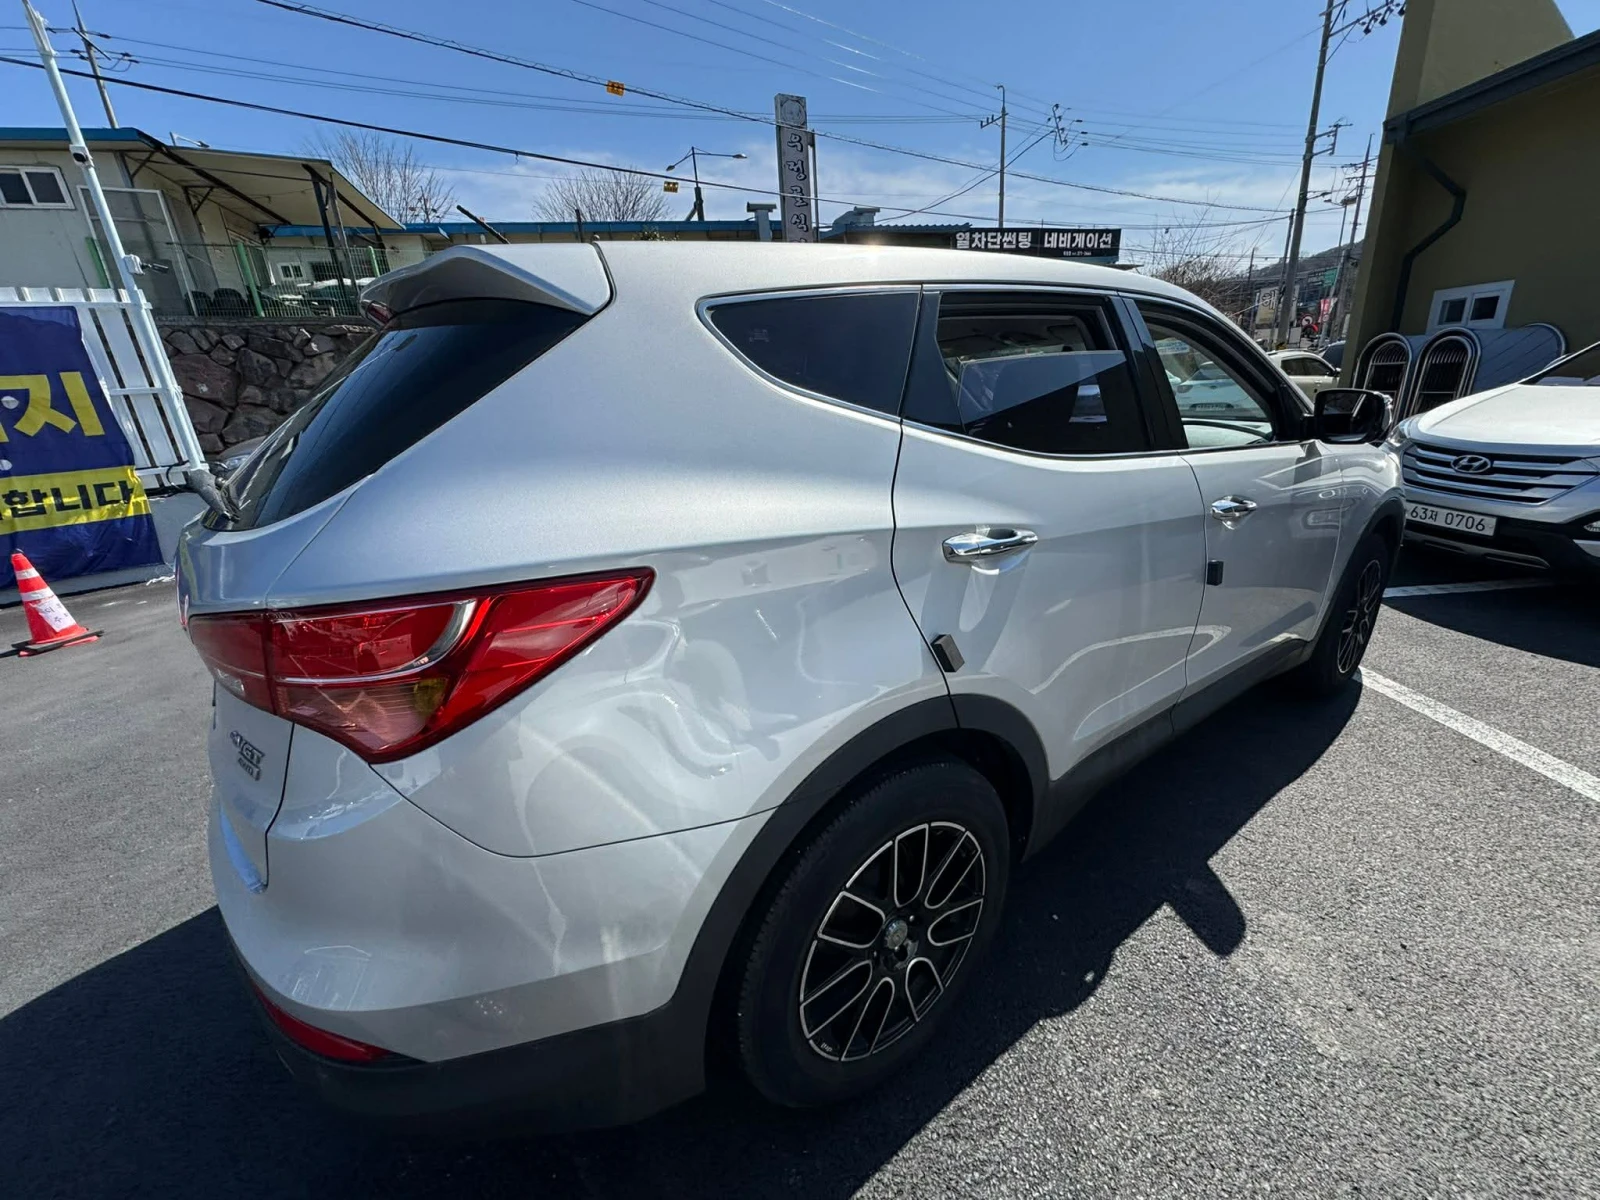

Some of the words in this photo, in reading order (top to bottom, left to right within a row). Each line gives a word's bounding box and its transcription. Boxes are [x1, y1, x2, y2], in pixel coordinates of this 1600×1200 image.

[955, 231, 1032, 249] 열차단썬팅
[1043, 231, 1113, 249] 네비게이션
[0, 371, 106, 442] 지
[0, 480, 134, 521] 합니다
[1444, 511, 1486, 532] 0706
